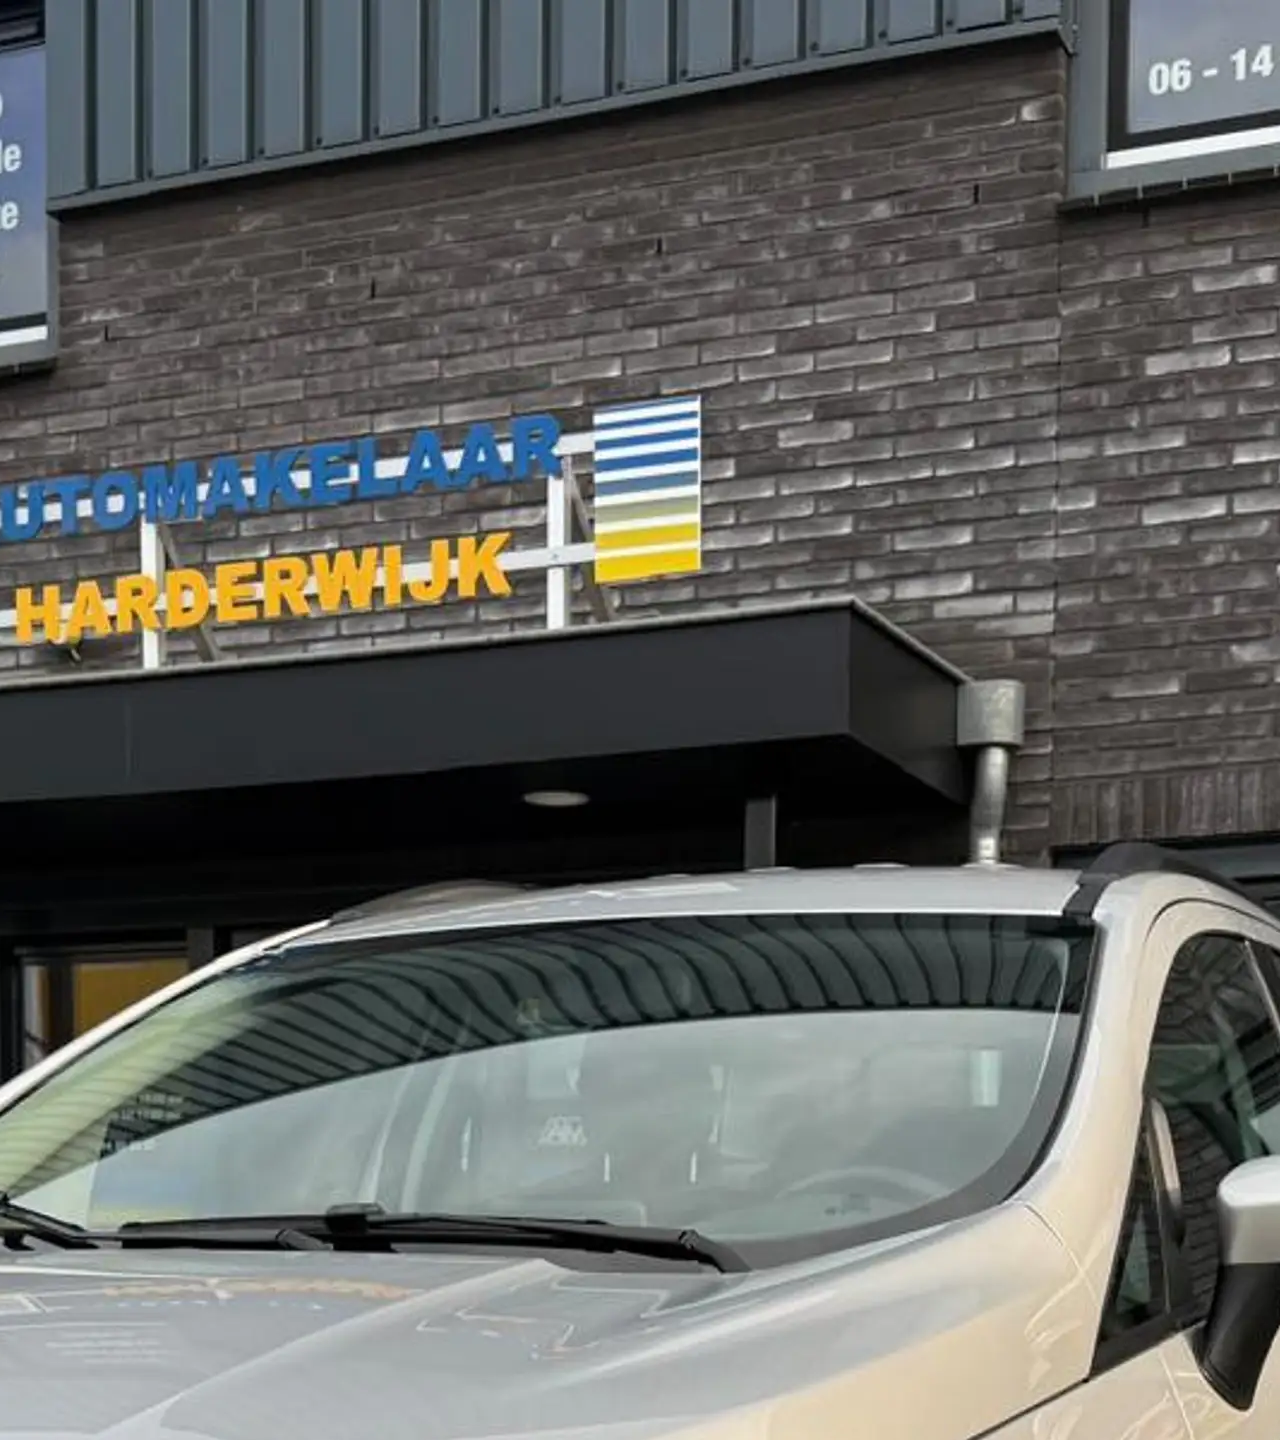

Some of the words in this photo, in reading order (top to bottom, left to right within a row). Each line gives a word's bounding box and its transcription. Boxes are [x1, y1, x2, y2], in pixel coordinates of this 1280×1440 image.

[1148, 58, 1192, 95] 06
[1230, 45, 1274, 81] 14
[16, 531, 512, 644] HARDERWIJK
